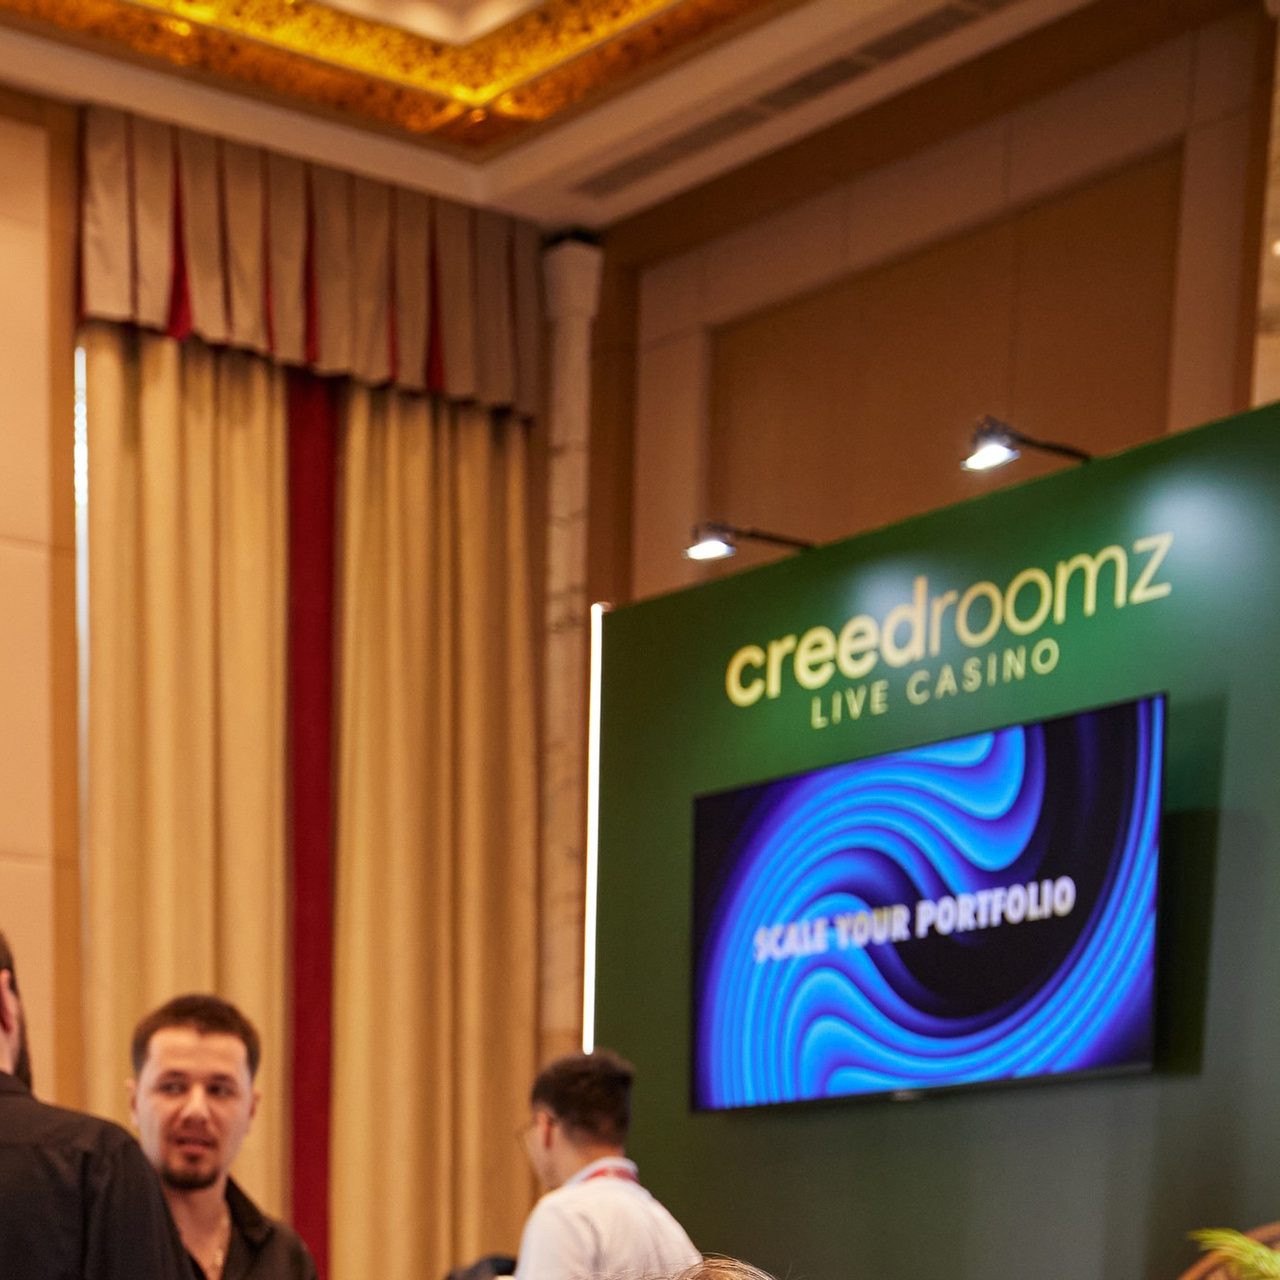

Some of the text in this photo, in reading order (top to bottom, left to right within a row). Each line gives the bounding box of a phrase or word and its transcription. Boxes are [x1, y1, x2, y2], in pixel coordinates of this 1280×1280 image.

[725, 533, 1174, 706] creedroomz
[810, 638, 1060, 728] LIVE CASINO
[753, 875, 1076, 964] SCALE YOUR PORTFOLIO
